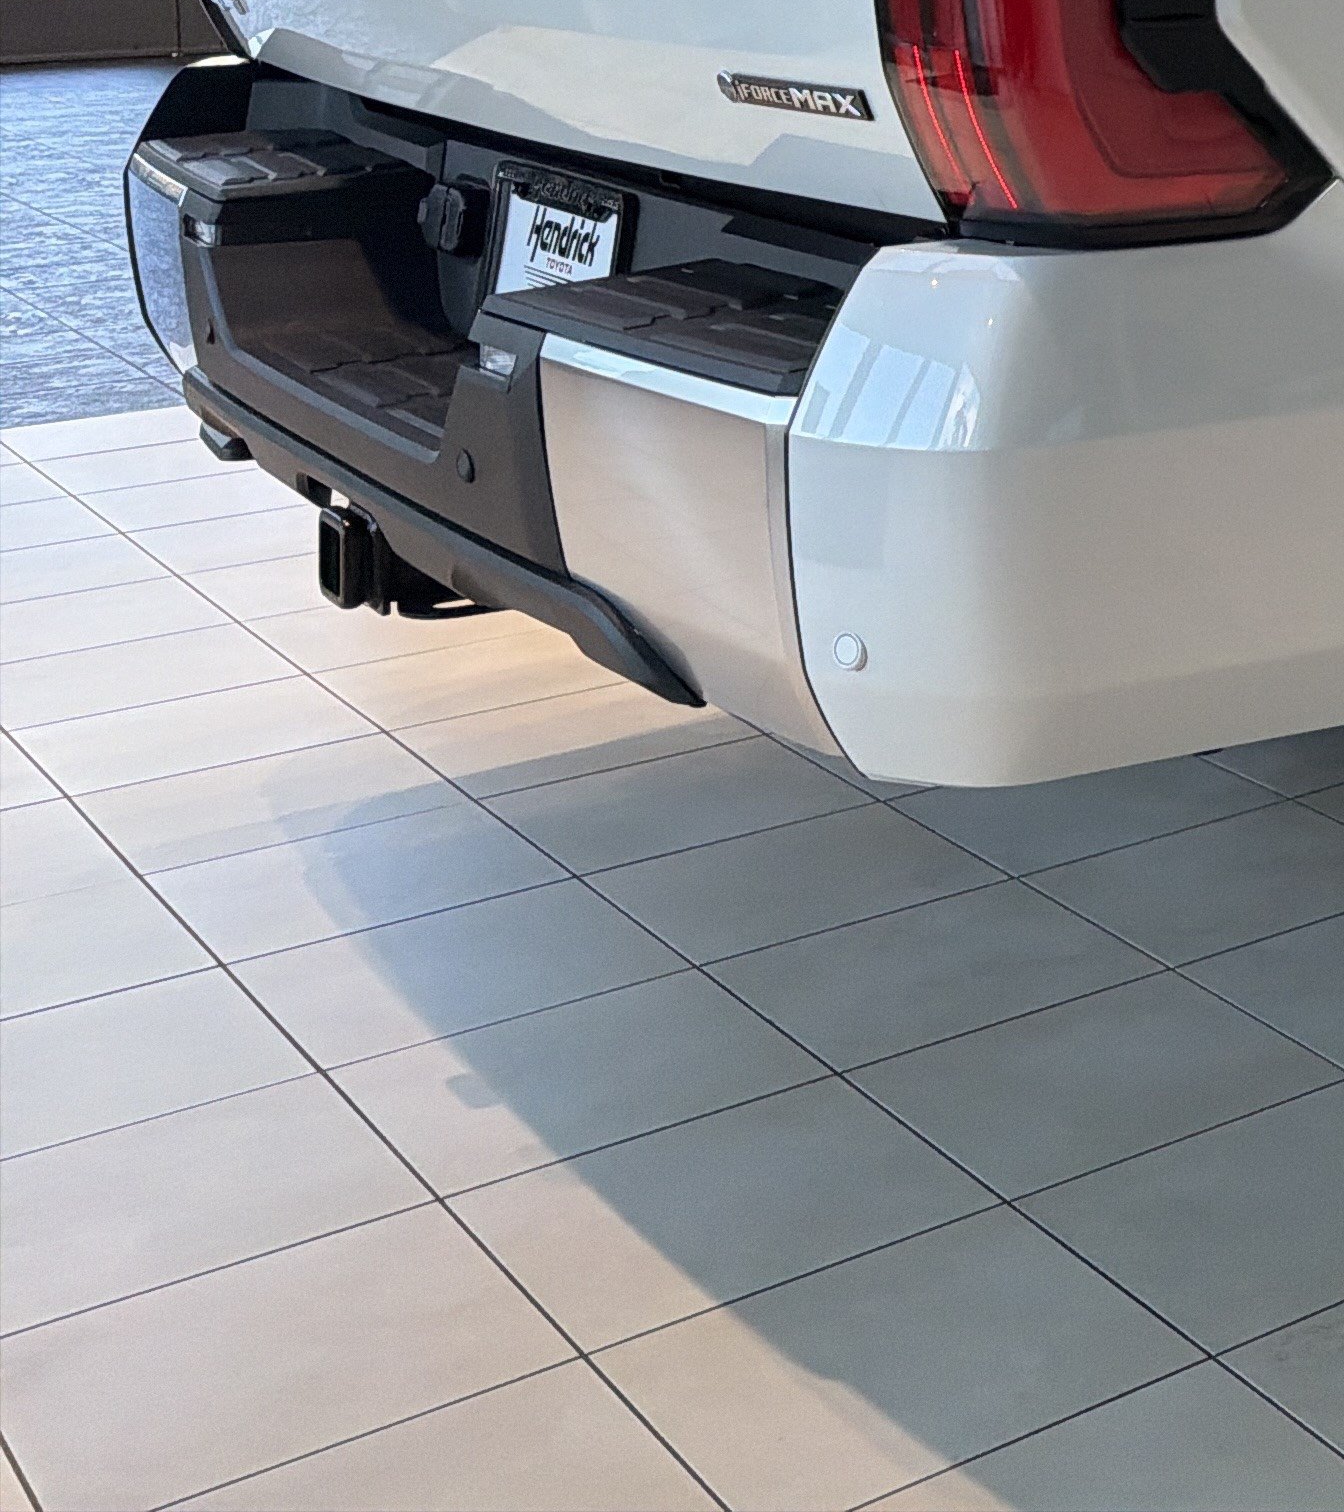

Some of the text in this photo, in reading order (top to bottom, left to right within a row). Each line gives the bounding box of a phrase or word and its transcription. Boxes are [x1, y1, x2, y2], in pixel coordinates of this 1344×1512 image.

[788, 88, 862, 117] MAX
[527, 205, 600, 267] Hendrick
[546, 258, 573, 275] TOYOTA
